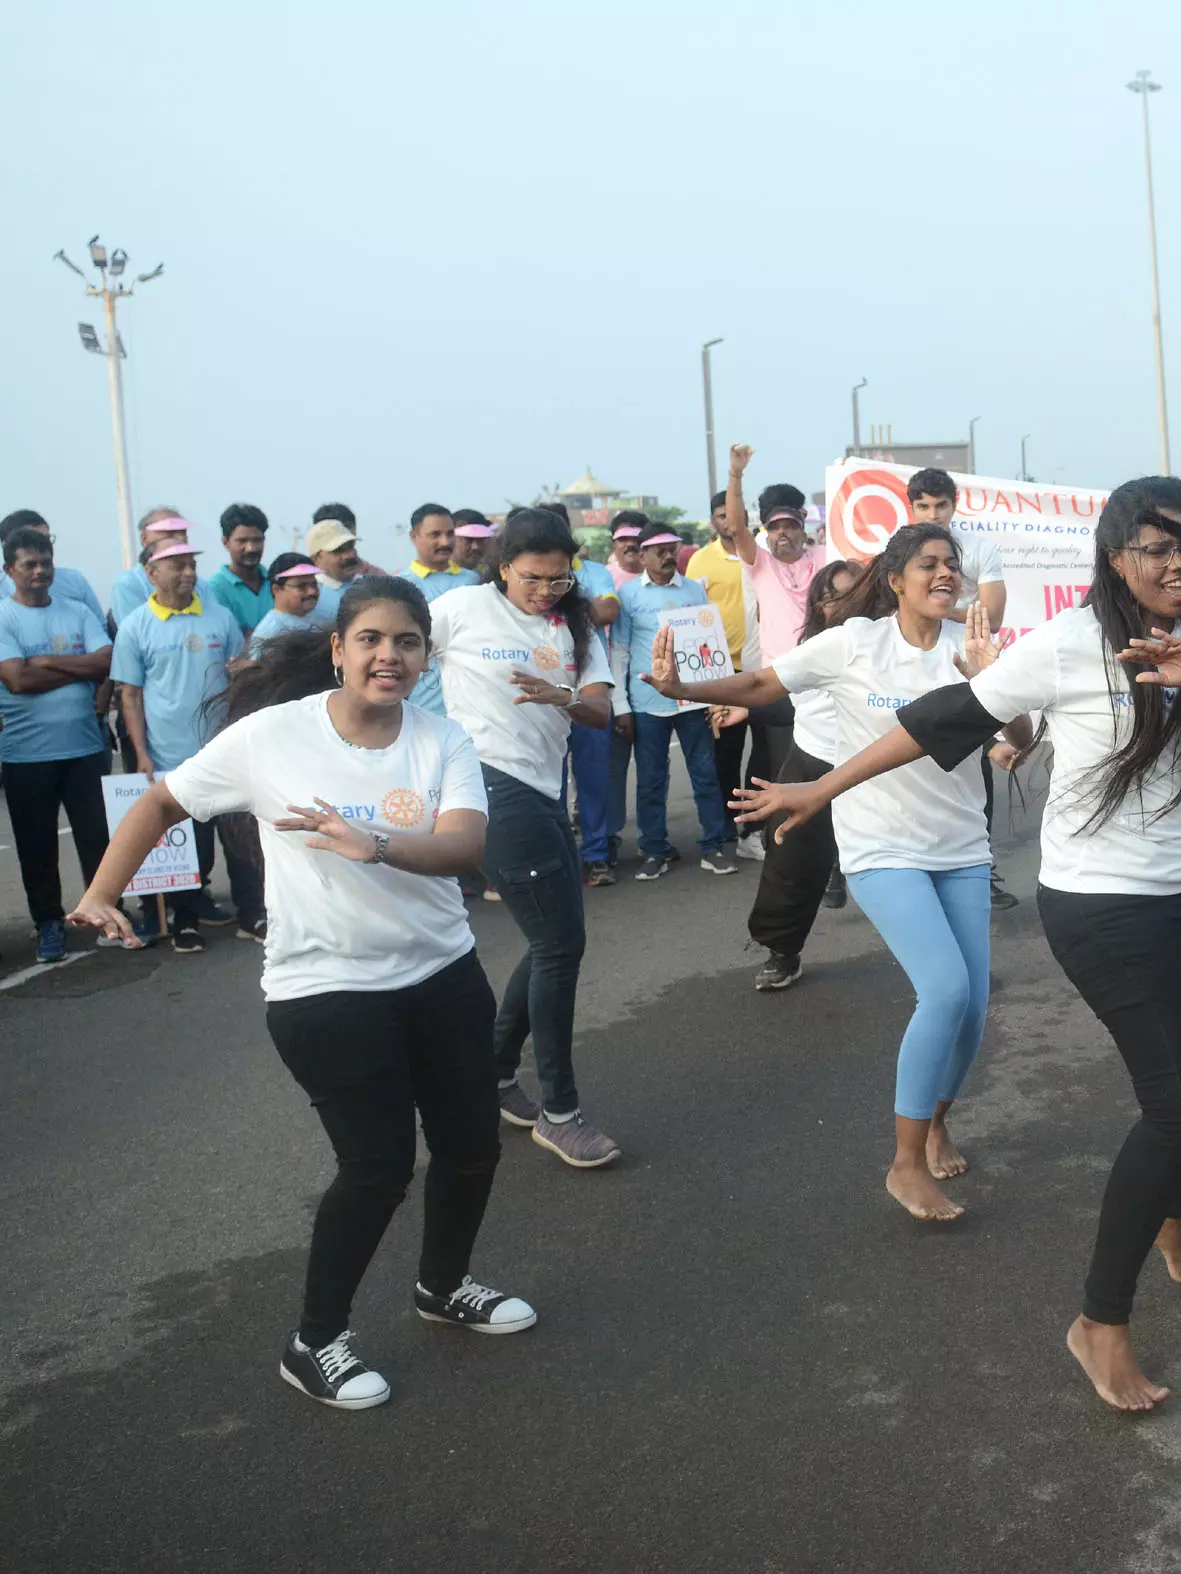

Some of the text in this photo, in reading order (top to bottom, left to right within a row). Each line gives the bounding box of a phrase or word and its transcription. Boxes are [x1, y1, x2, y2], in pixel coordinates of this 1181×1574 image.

[955, 487, 1108, 517] UANTU
[951, 520, 1090, 536] ECIALITY DIAGNO
[482, 648, 530, 661] Rotary
[867, 692, 912, 710] Rotar
[115, 787, 148, 798] Rotar
